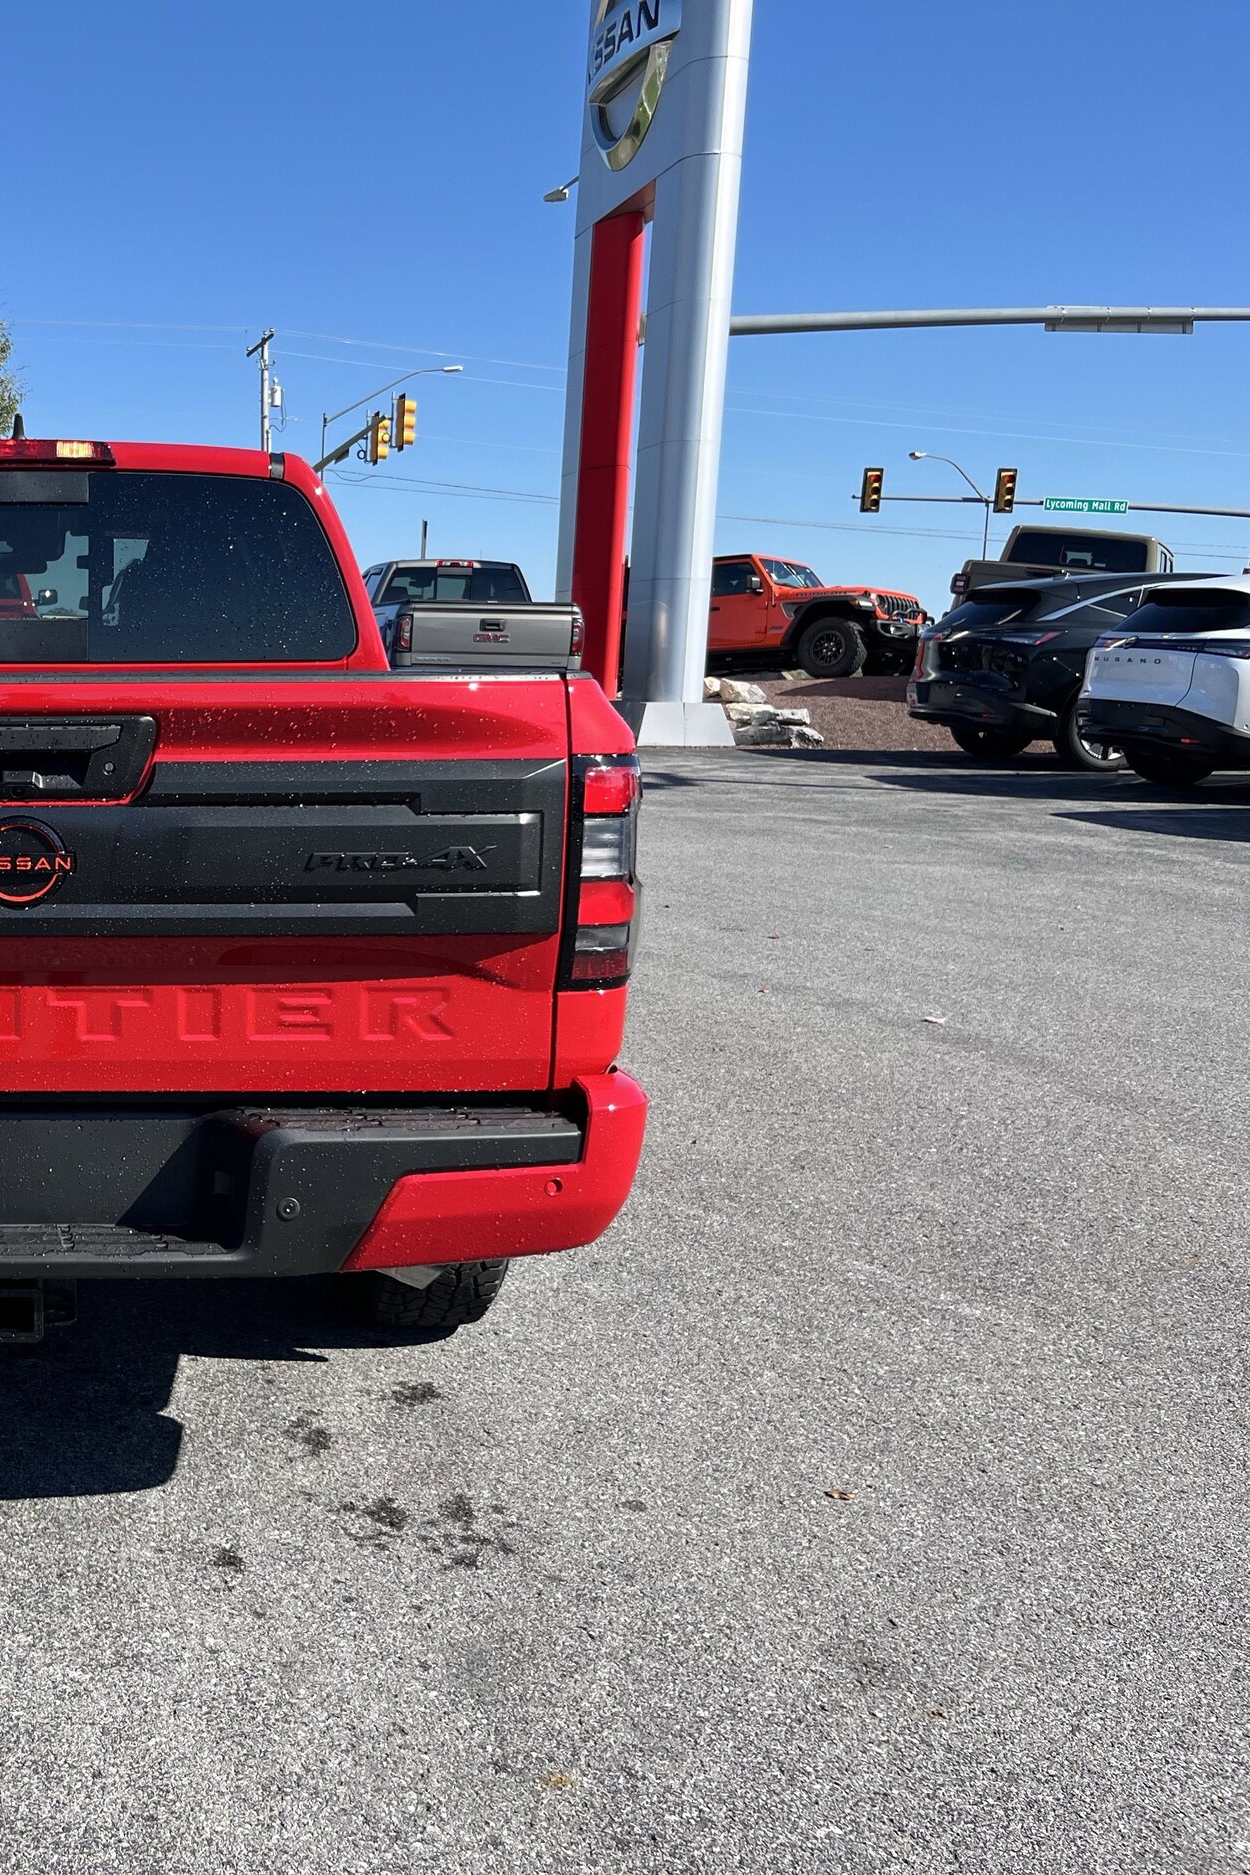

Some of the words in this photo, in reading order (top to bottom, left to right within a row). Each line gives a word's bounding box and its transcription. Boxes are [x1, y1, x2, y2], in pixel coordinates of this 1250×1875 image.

[1046, 499, 1089, 512] Lycoming
[1091, 501, 1110, 511] Mall
[1113, 502, 1126, 512] Rd
[472, 633, 510, 643] GMC
